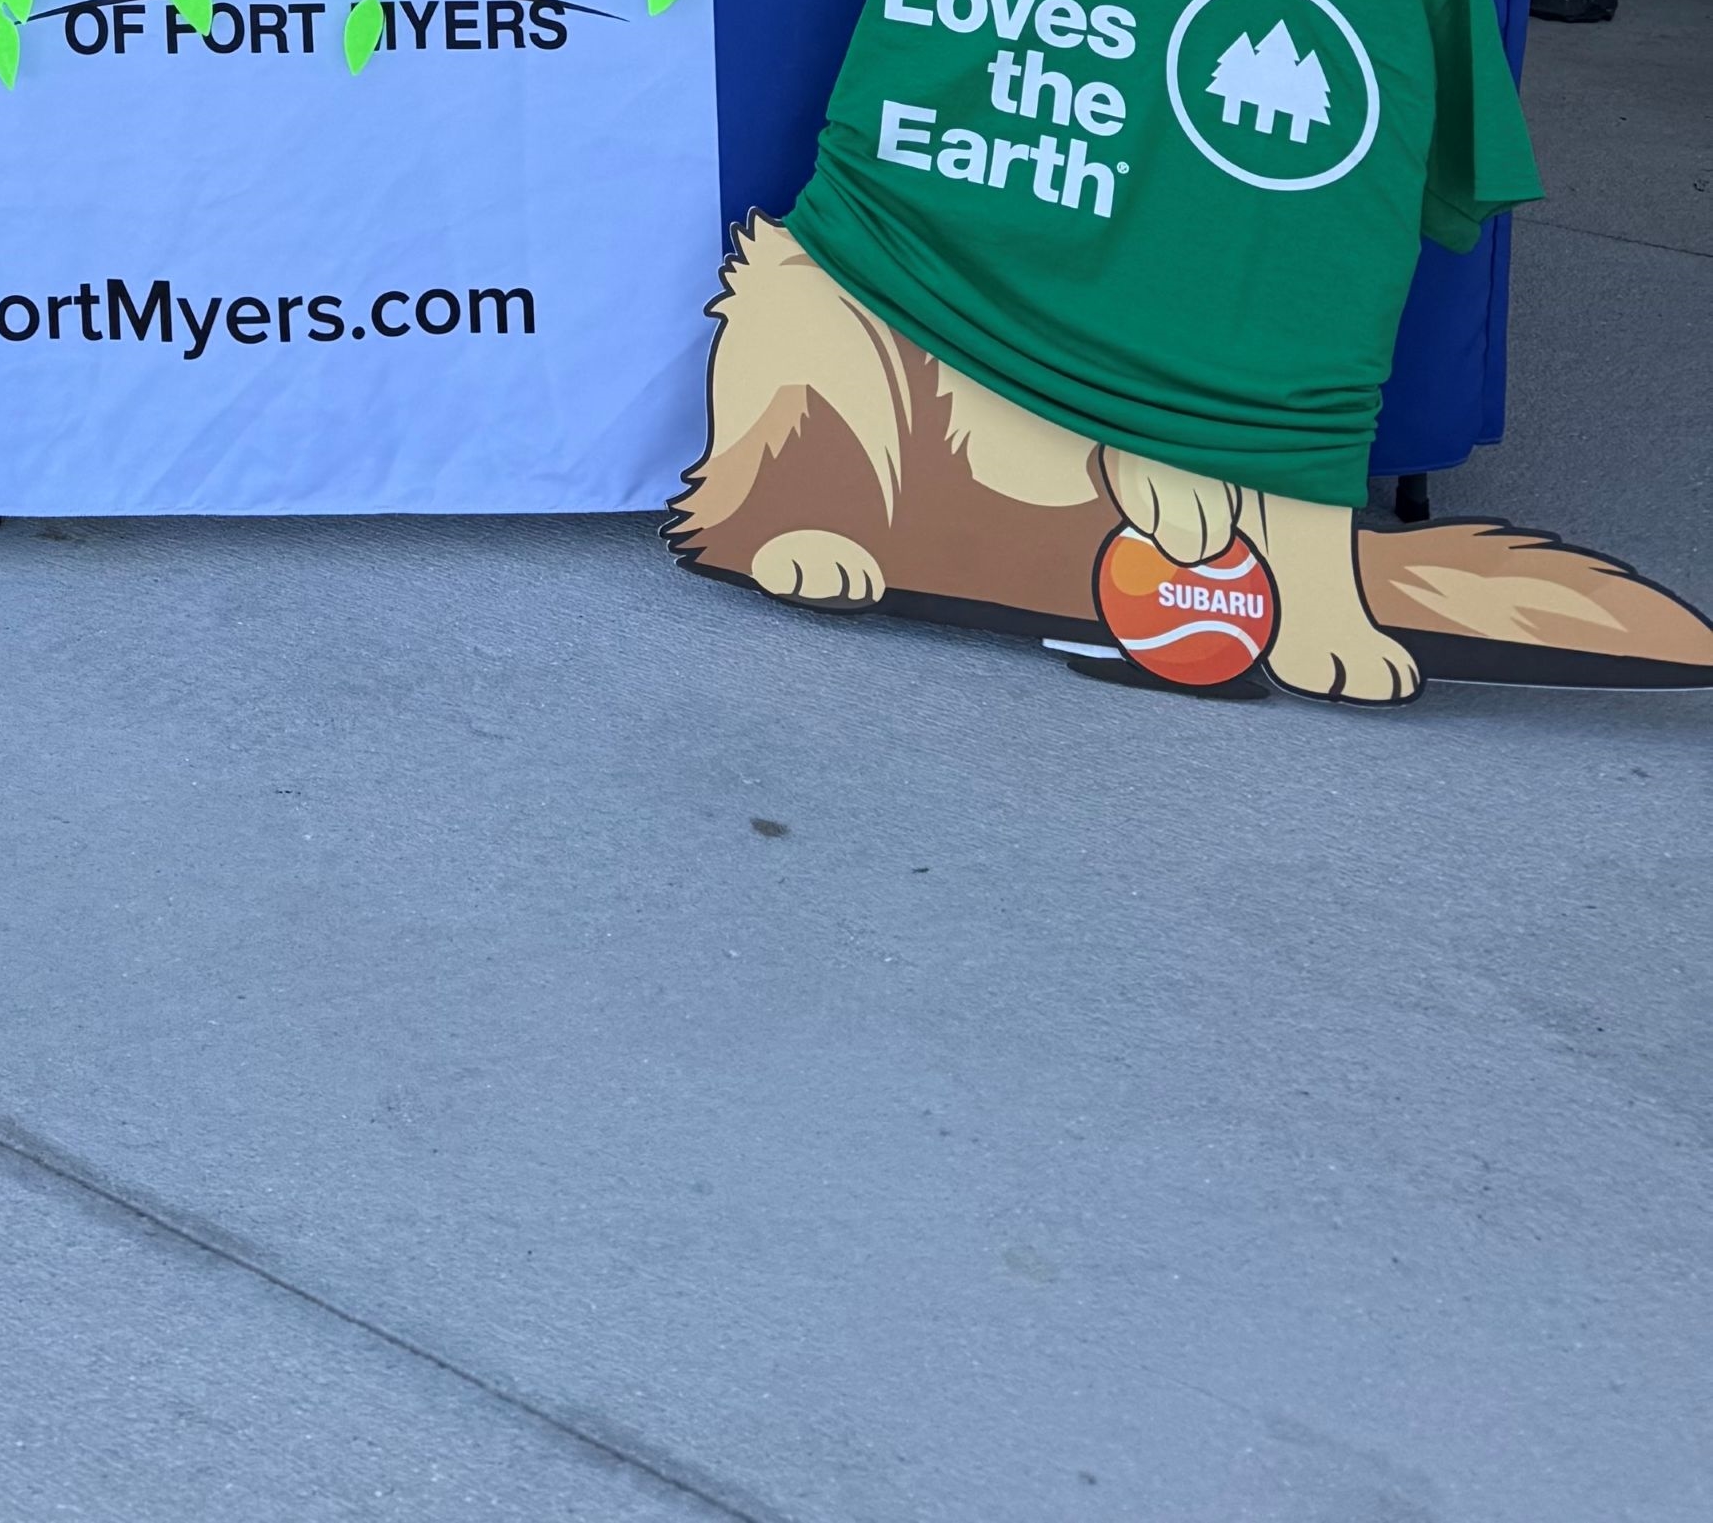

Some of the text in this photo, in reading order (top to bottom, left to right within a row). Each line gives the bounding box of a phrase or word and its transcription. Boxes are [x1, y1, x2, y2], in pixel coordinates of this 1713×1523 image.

[64, 3, 146, 55] OF
[166, 2, 326, 54] FORT
[986, 48, 1127, 137] the
[876, 100, 1116, 218] Earth
[1157, 581, 1264, 619] SUBARU
